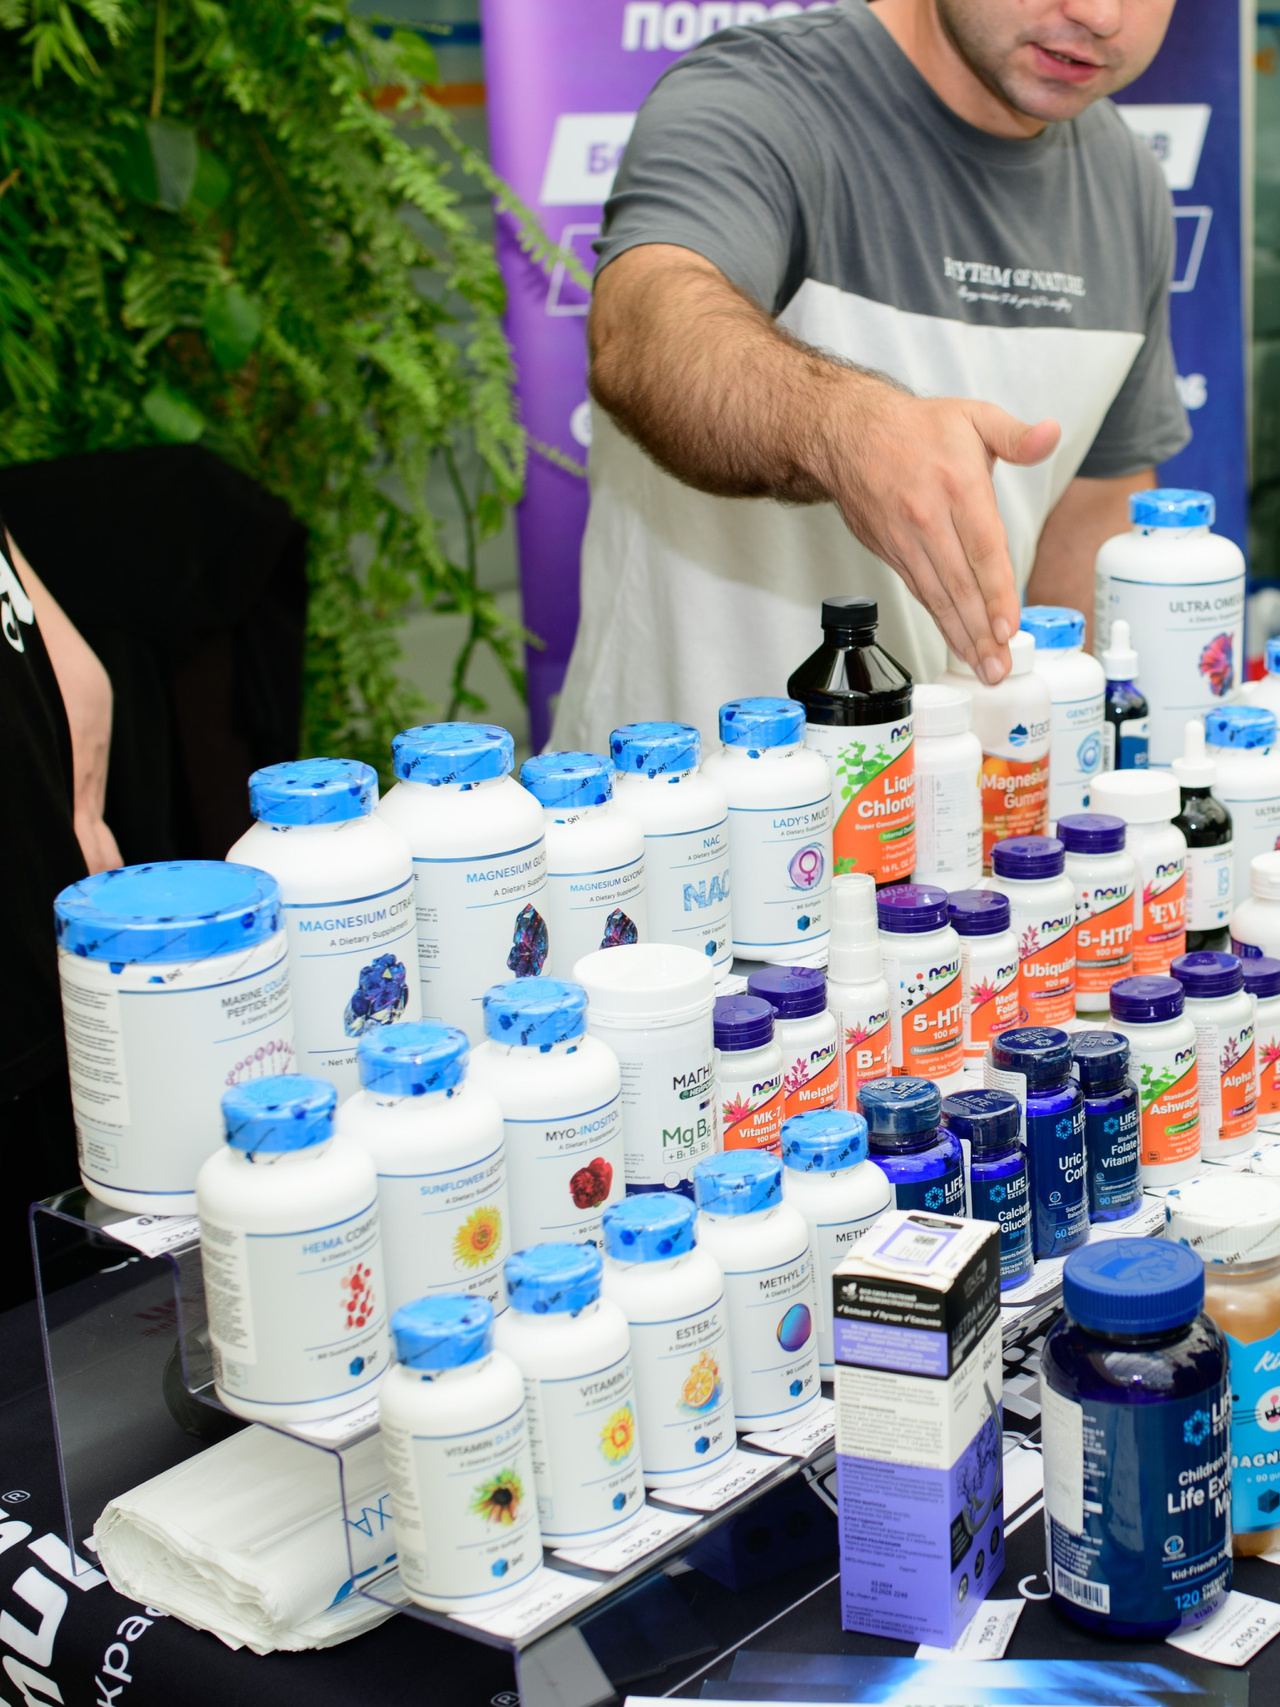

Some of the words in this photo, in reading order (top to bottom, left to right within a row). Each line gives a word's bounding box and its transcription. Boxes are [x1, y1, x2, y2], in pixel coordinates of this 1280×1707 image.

[1030, 269, 1086, 296] NATURE
[1169, 598, 1211, 613] ULTRA
[773, 815, 809, 829] LADY'S
[786, 827, 805, 836] Dietary
[703, 834, 720, 849] NAC
[693, 851, 710, 861] Dietary
[466, 860, 532, 884] MAGNESIUM
[501, 883, 526, 896] Dietary
[570, 878, 621, 893] MAGNESIUM
[683, 869, 730, 912] NAC
[595, 892, 615, 902] Dietary
[299, 908, 387, 933] MAGNESIUM
[812, 915, 822, 925] SNT
[339, 934, 371, 947] Dietary
[372, 919, 409, 940] Supplement
[1077, 923, 1133, 946] 5-HTP
[717, 938, 727, 950] SNT
[1096, 947, 1111, 957] 100
[1112, 946, 1124, 957] mg
[1045, 979, 1057, 988] 100
[1058, 976, 1070, 987] mg
[221, 986, 263, 1008] MARINE
[227, 997, 268, 1019] PEPTIDE
[933, 1029, 948, 1040] 100
[949, 1026, 959, 1037] mg
[328, 1058, 345, 1068] Net
[856, 1064, 886, 1077] Liposomal
[1223, 1070, 1252, 1088] Alpha
[825, 1095, 834, 1104] mg
[753, 1106, 781, 1126] MK-7
[1119, 1109, 1137, 1125] LIFE
[662, 1127, 694, 1148] Mg
[739, 1120, 776, 1139] Vitamin
[565, 1139, 588, 1150] Dietary
[757, 1136, 769, 1144] 100
[1111, 1140, 1137, 1155] Folate
[1059, 1153, 1081, 1171] Uric
[1101, 1152, 1137, 1169] Vitamin
[420, 1172, 486, 1197] SUNFLOWER
[944, 1177, 964, 1199] LIFE
[1006, 1176, 1026, 1193] LIFE
[998, 1200, 1030, 1221] Calcium
[1055, 1228, 1067, 1239] 60
[302, 1232, 343, 1256] HEMA
[759, 1268, 801, 1291] METHYL
[770, 1287, 791, 1298] Dietary
[580, 1370, 625, 1397] VITAMIN
[445, 1440, 494, 1457] VITAMIN
[1255, 1473, 1268, 1484] 90
[1167, 1489, 1205, 1514] Life
[1171, 1555, 1217, 1582] Kid-Friendly
[1174, 1589, 1201, 1611] 120
